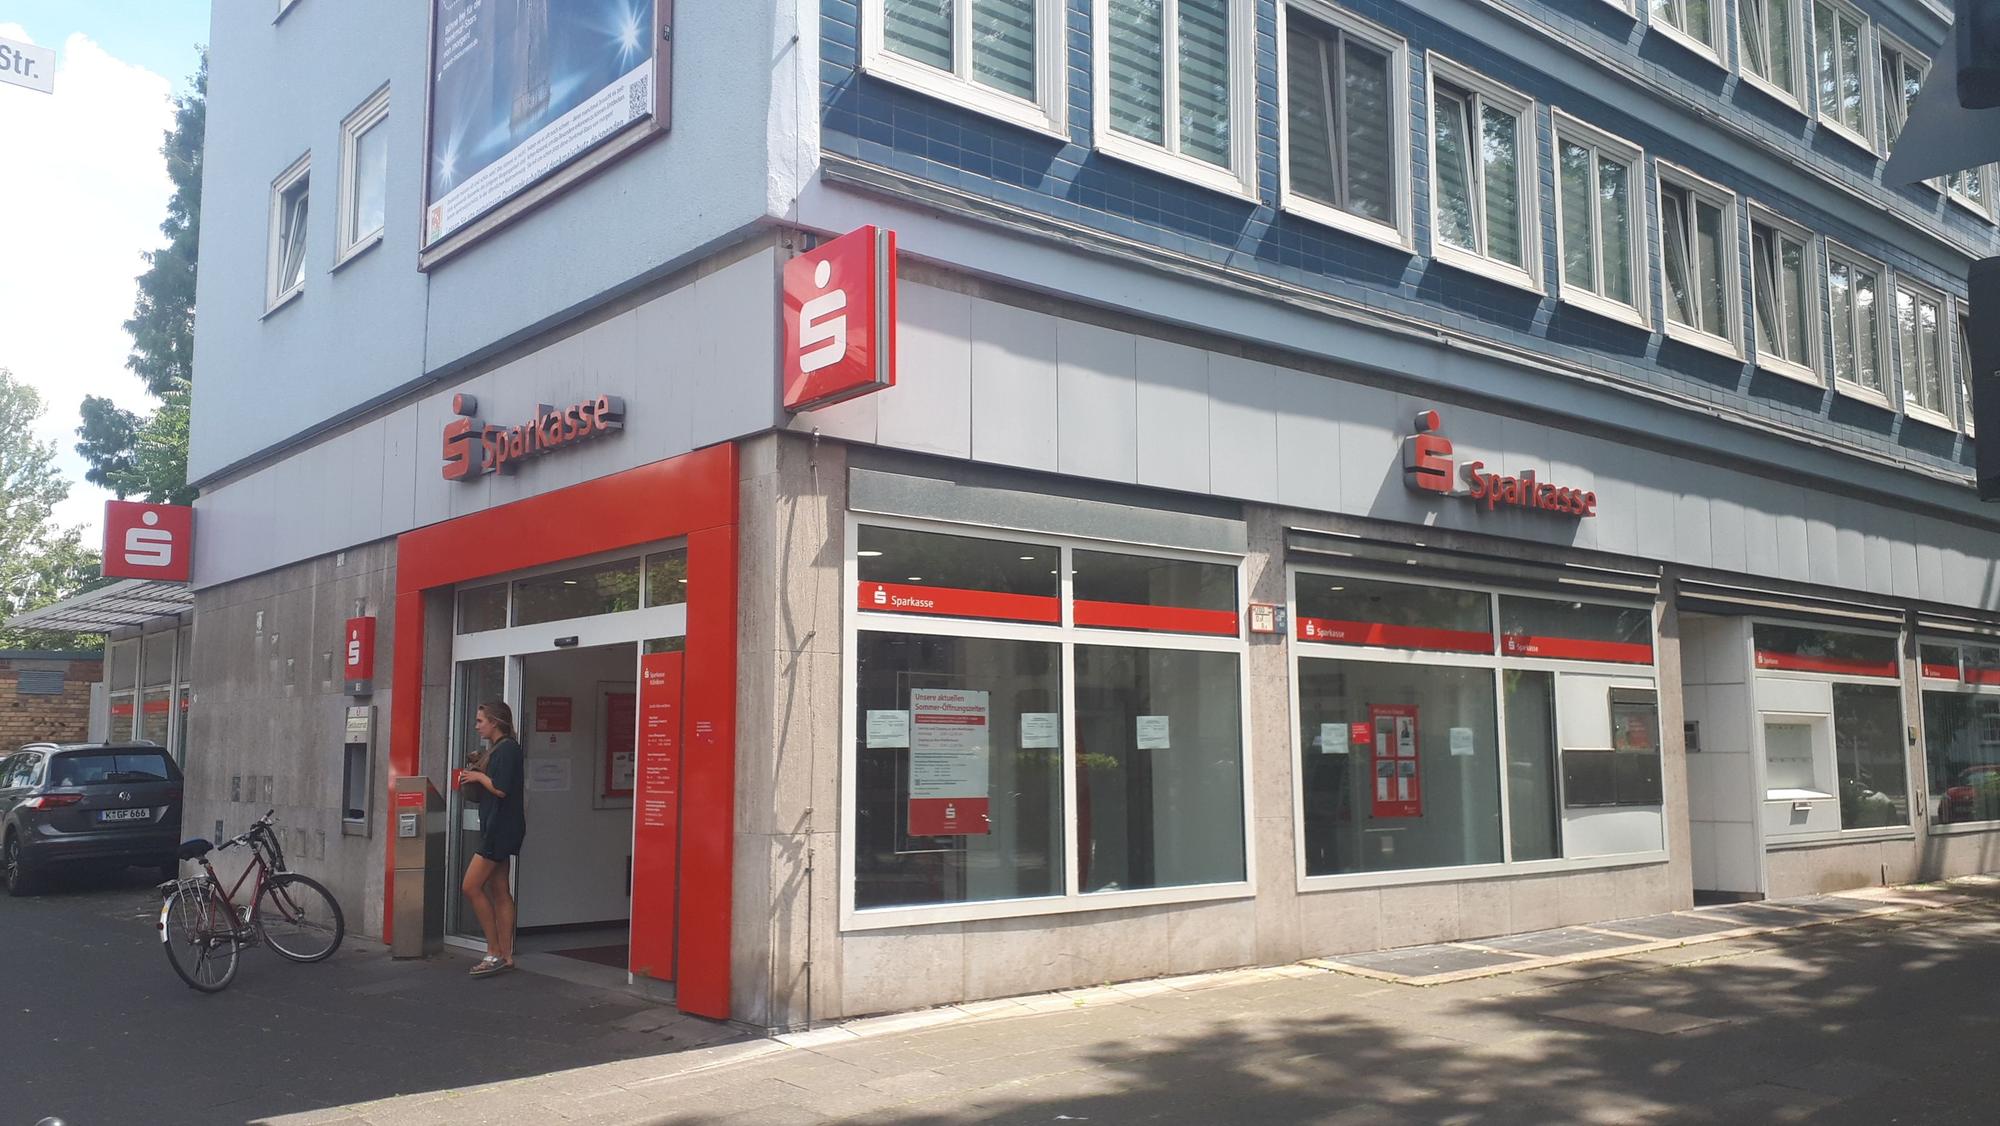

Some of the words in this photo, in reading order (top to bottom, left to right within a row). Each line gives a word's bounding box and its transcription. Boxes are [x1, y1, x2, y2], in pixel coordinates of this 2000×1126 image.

[0, 44, 39, 78] Str.
[481, 393, 615, 475] Sparkasse
[1469, 459, 1597, 517] Sparkasse
[891, 595, 934, 608] Sparkasse
[1316, 627, 1345, 639] Sparkasse
[915, 693, 937, 701] Unsere
[937, 694, 965, 702] aktuellen
[914, 703, 986, 713] Sommer-Öffnungszeiten
[130, 809, 146, 818] 666
